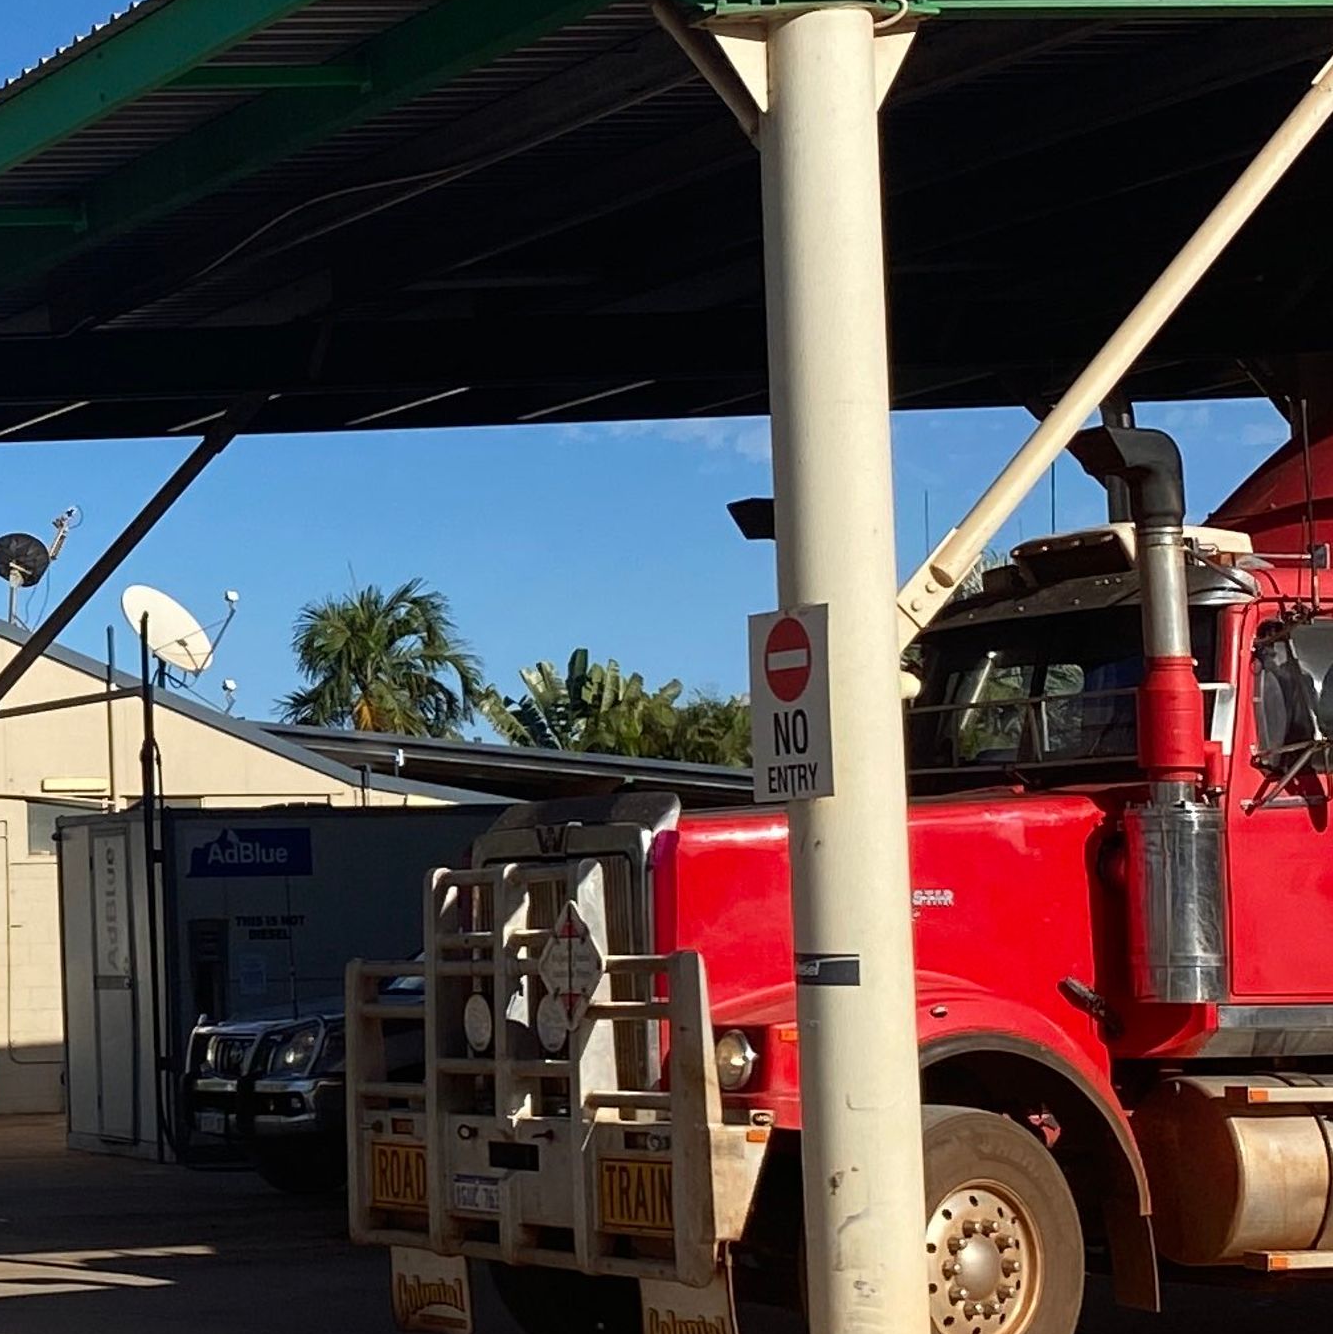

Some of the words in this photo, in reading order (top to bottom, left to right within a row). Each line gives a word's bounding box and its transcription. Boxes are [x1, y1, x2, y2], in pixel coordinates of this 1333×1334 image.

[773, 709, 809, 756] NO
[768, 762, 818, 797] ENTRY
[207, 841, 289, 865] AdBlue
[235, 915, 264, 927] THIS
[265, 915, 278, 927] IS
[280, 915, 305, 927] NOT
[248, 928, 292, 940] DIESEL
[378, 1148, 427, 1201] ROAD
[605, 1164, 672, 1223] TRAIN
[397, 1272, 465, 1323] Colonial
